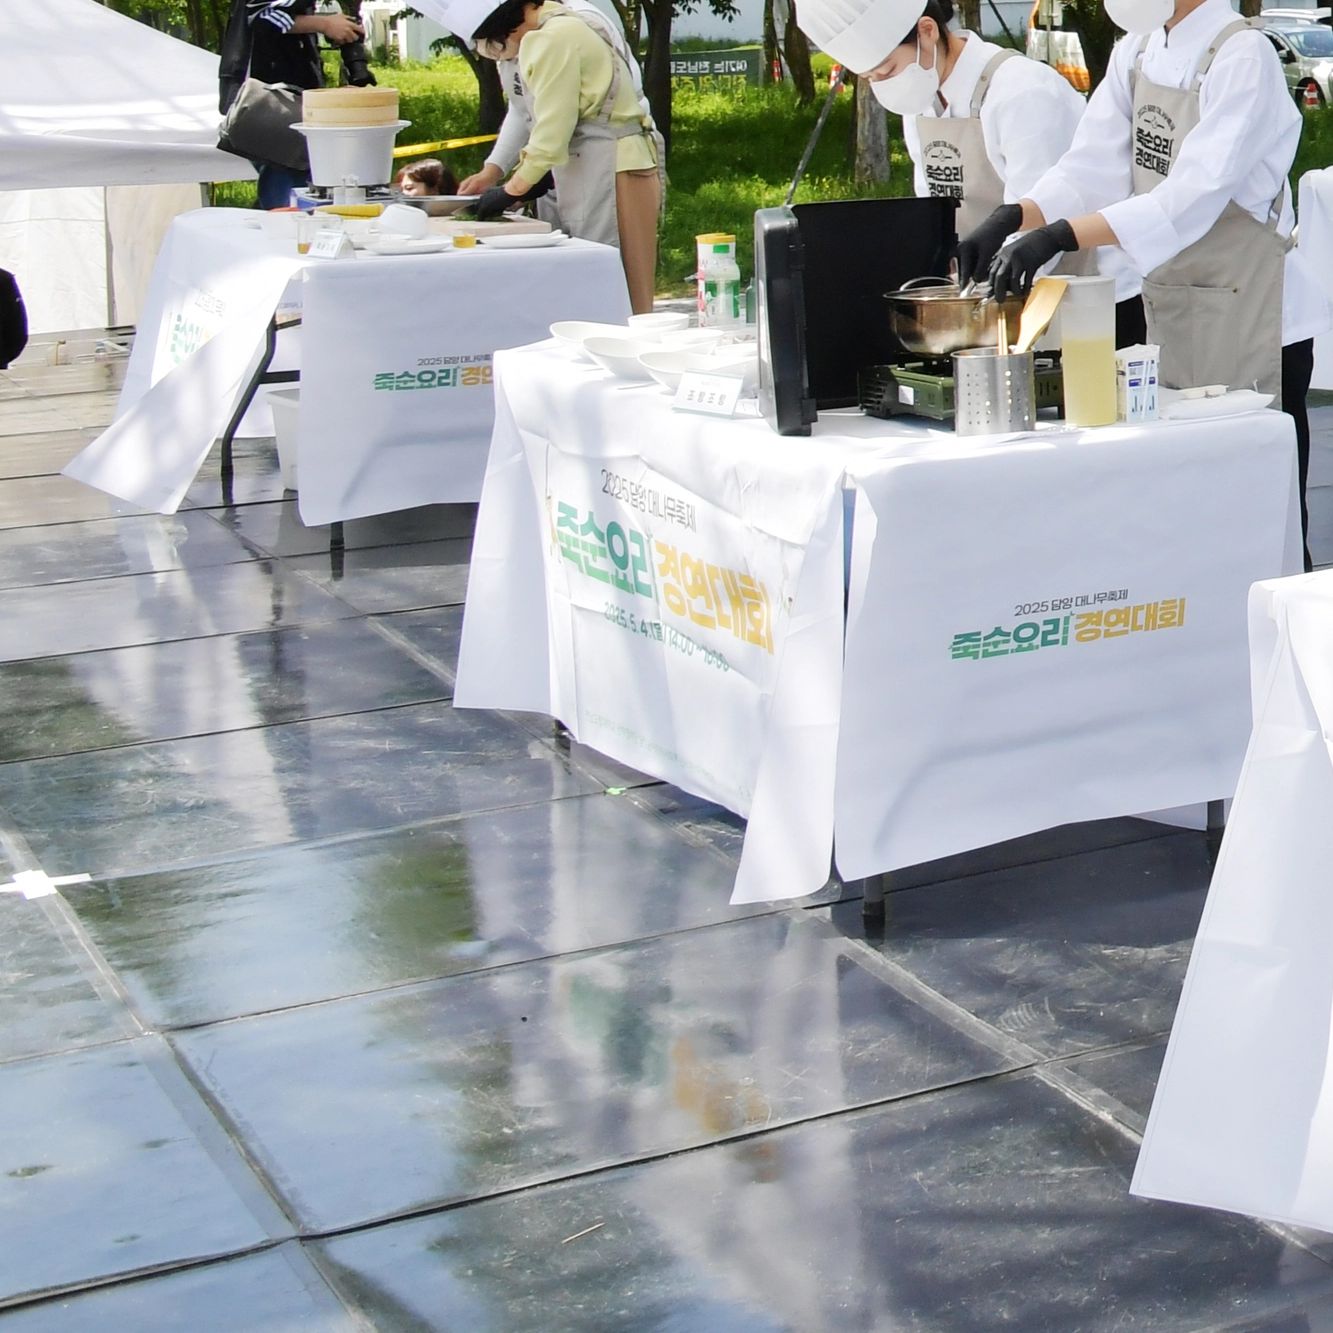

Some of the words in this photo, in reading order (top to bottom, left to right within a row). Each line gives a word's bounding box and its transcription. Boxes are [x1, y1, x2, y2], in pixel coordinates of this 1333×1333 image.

[1136, 127, 1174, 158] 죽순요리
[925, 164, 964, 184] 죽순요리
[1135, 147, 1170, 178] 경연대회
[417, 357, 443, 366] 2025
[373, 367, 458, 391] 죽순요리
[601, 468, 630, 503] 2025
[556, 500, 660, 603] 죽순요리
[655, 538, 775, 655] 경연대회
[1014, 600, 1049, 616] 2025
[1051, 597, 1074, 612] 담양
[1075, 588, 1129, 608] 대나무축제
[950, 613, 1071, 660] 죽순요리
[1075, 597, 1186, 643] 경연대회
